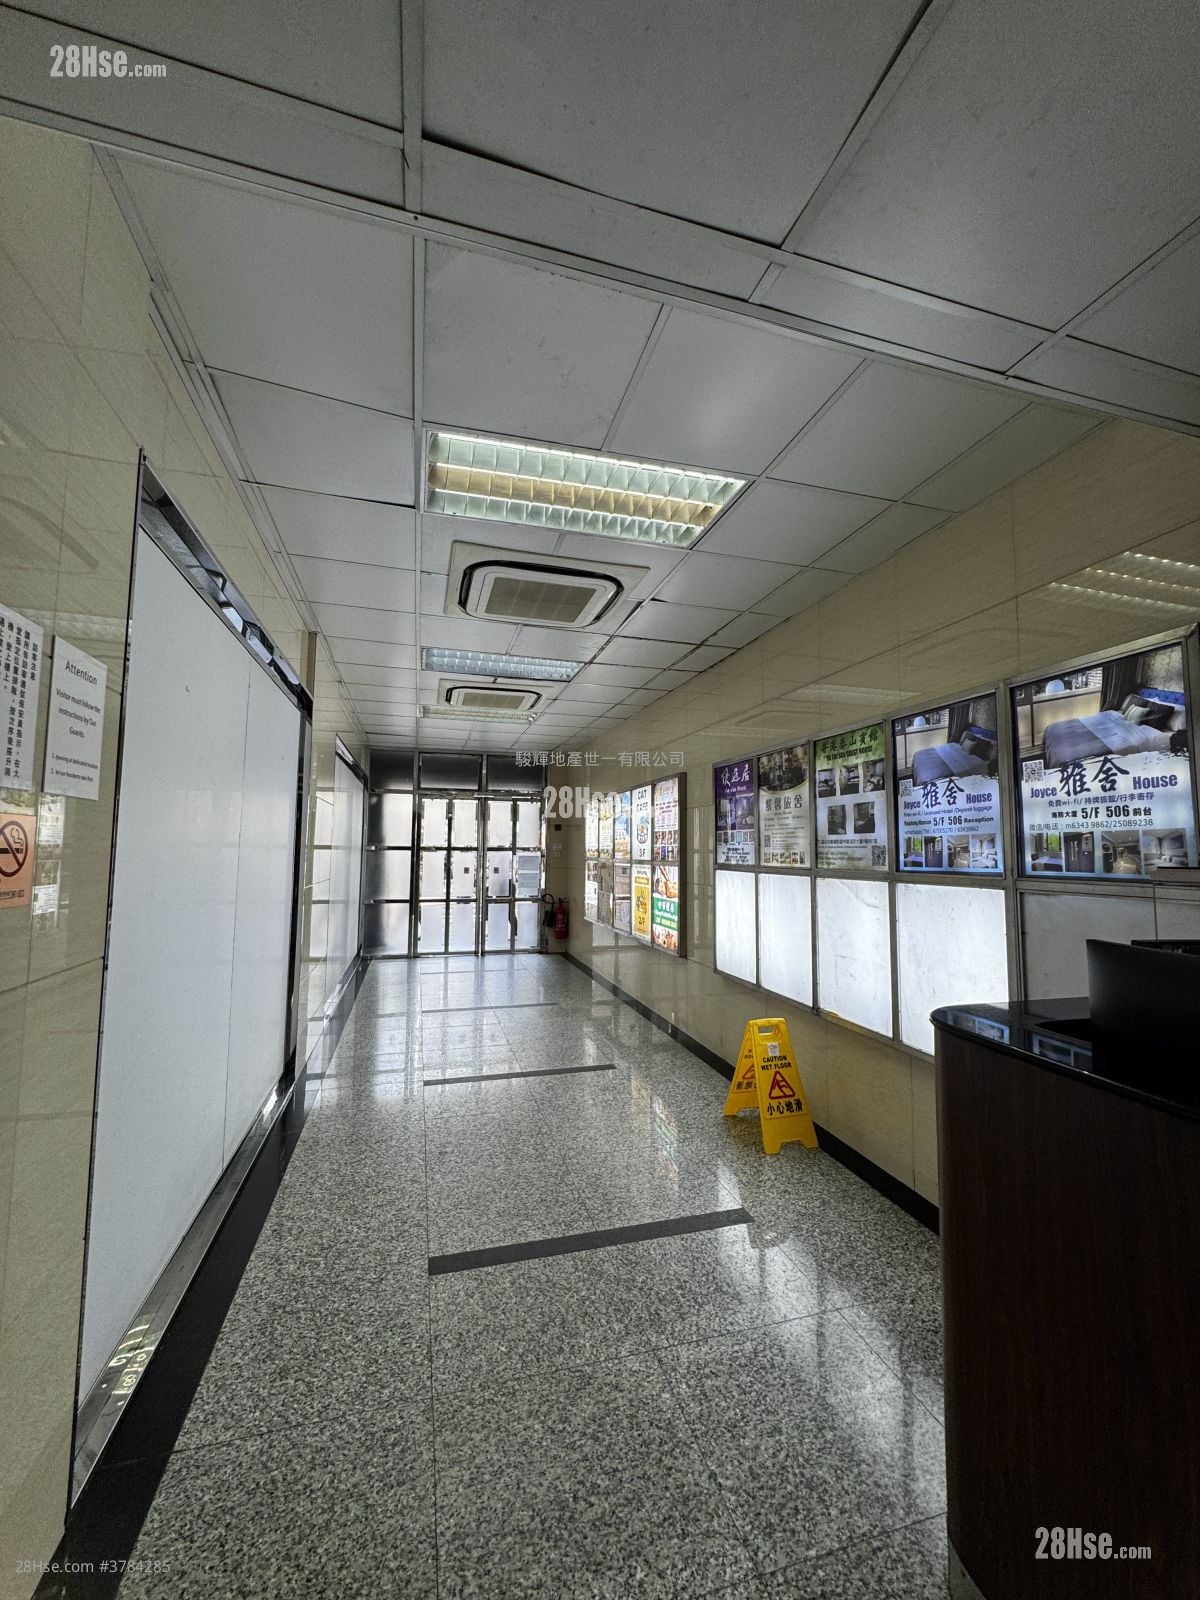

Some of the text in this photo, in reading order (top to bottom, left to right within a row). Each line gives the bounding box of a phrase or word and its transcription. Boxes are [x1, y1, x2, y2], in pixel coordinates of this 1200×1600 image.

[65, 660, 98, 686] Attention
[1058, 756, 1130, 798] 雅舍
[1132, 774, 1178, 790] House
[637, 789, 647, 800] CAT
[921, 777, 965, 809] 雅舍
[965, 792, 993, 804] House
[1030, 786, 1058, 799] Joyce
[903, 800, 921, 810] Joyce
[1081, 806, 1100, 819] 5/F
[1105, 804, 1130, 818] 506
[1132, 806, 1152, 817] 前台
[932, 816, 945, 827] 5/F
[947, 815, 963, 826] 506
[963, 816, 994, 824] Reception
[763, 1055, 787, 1063] CAUTION
[761, 1061, 792, 1071] WET FLOOR
[767, 1099, 802, 1115] 小心地滑
